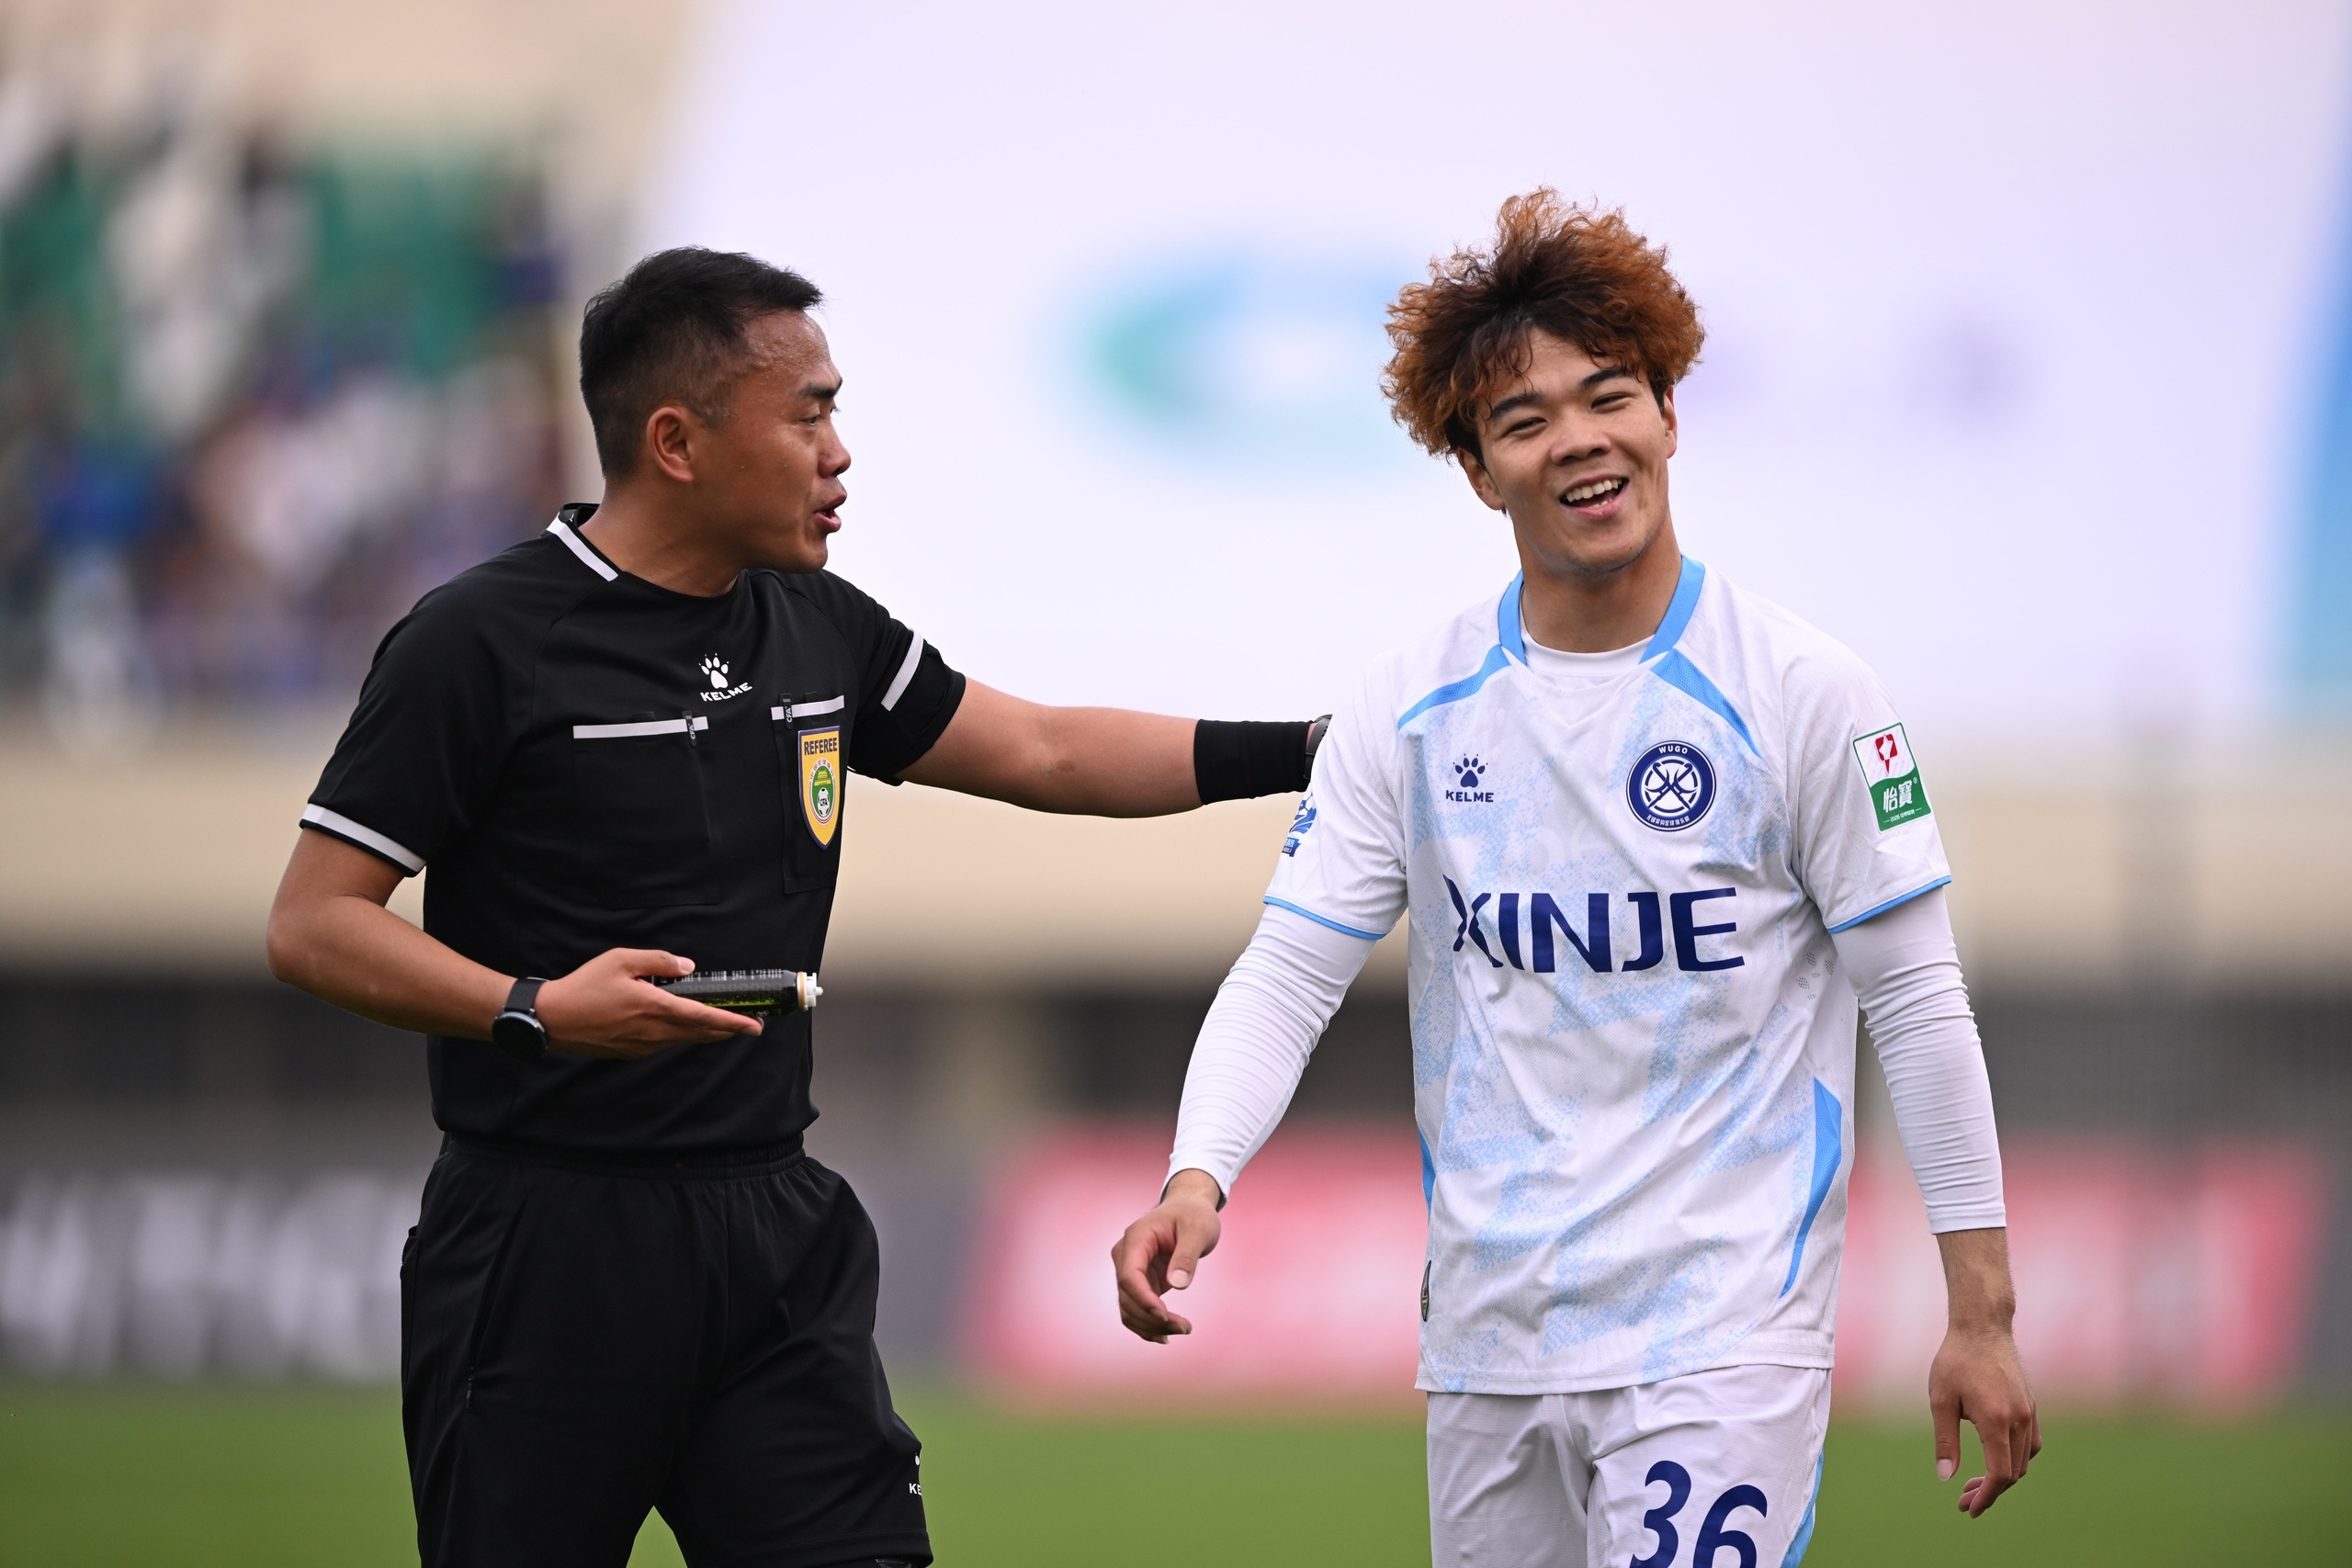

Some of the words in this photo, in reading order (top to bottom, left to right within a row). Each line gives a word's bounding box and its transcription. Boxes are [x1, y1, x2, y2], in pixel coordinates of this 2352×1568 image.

[700, 682, 752, 702] KELME
[785, 706, 793, 723] CFA
[804, 738, 837, 756] REFEREE
[1658, 745, 1688, 754] WUGO
[1445, 789, 1494, 803] KELME
[1442, 874, 1745, 973] XINJE
[1629, 1460, 1768, 1568] 36
